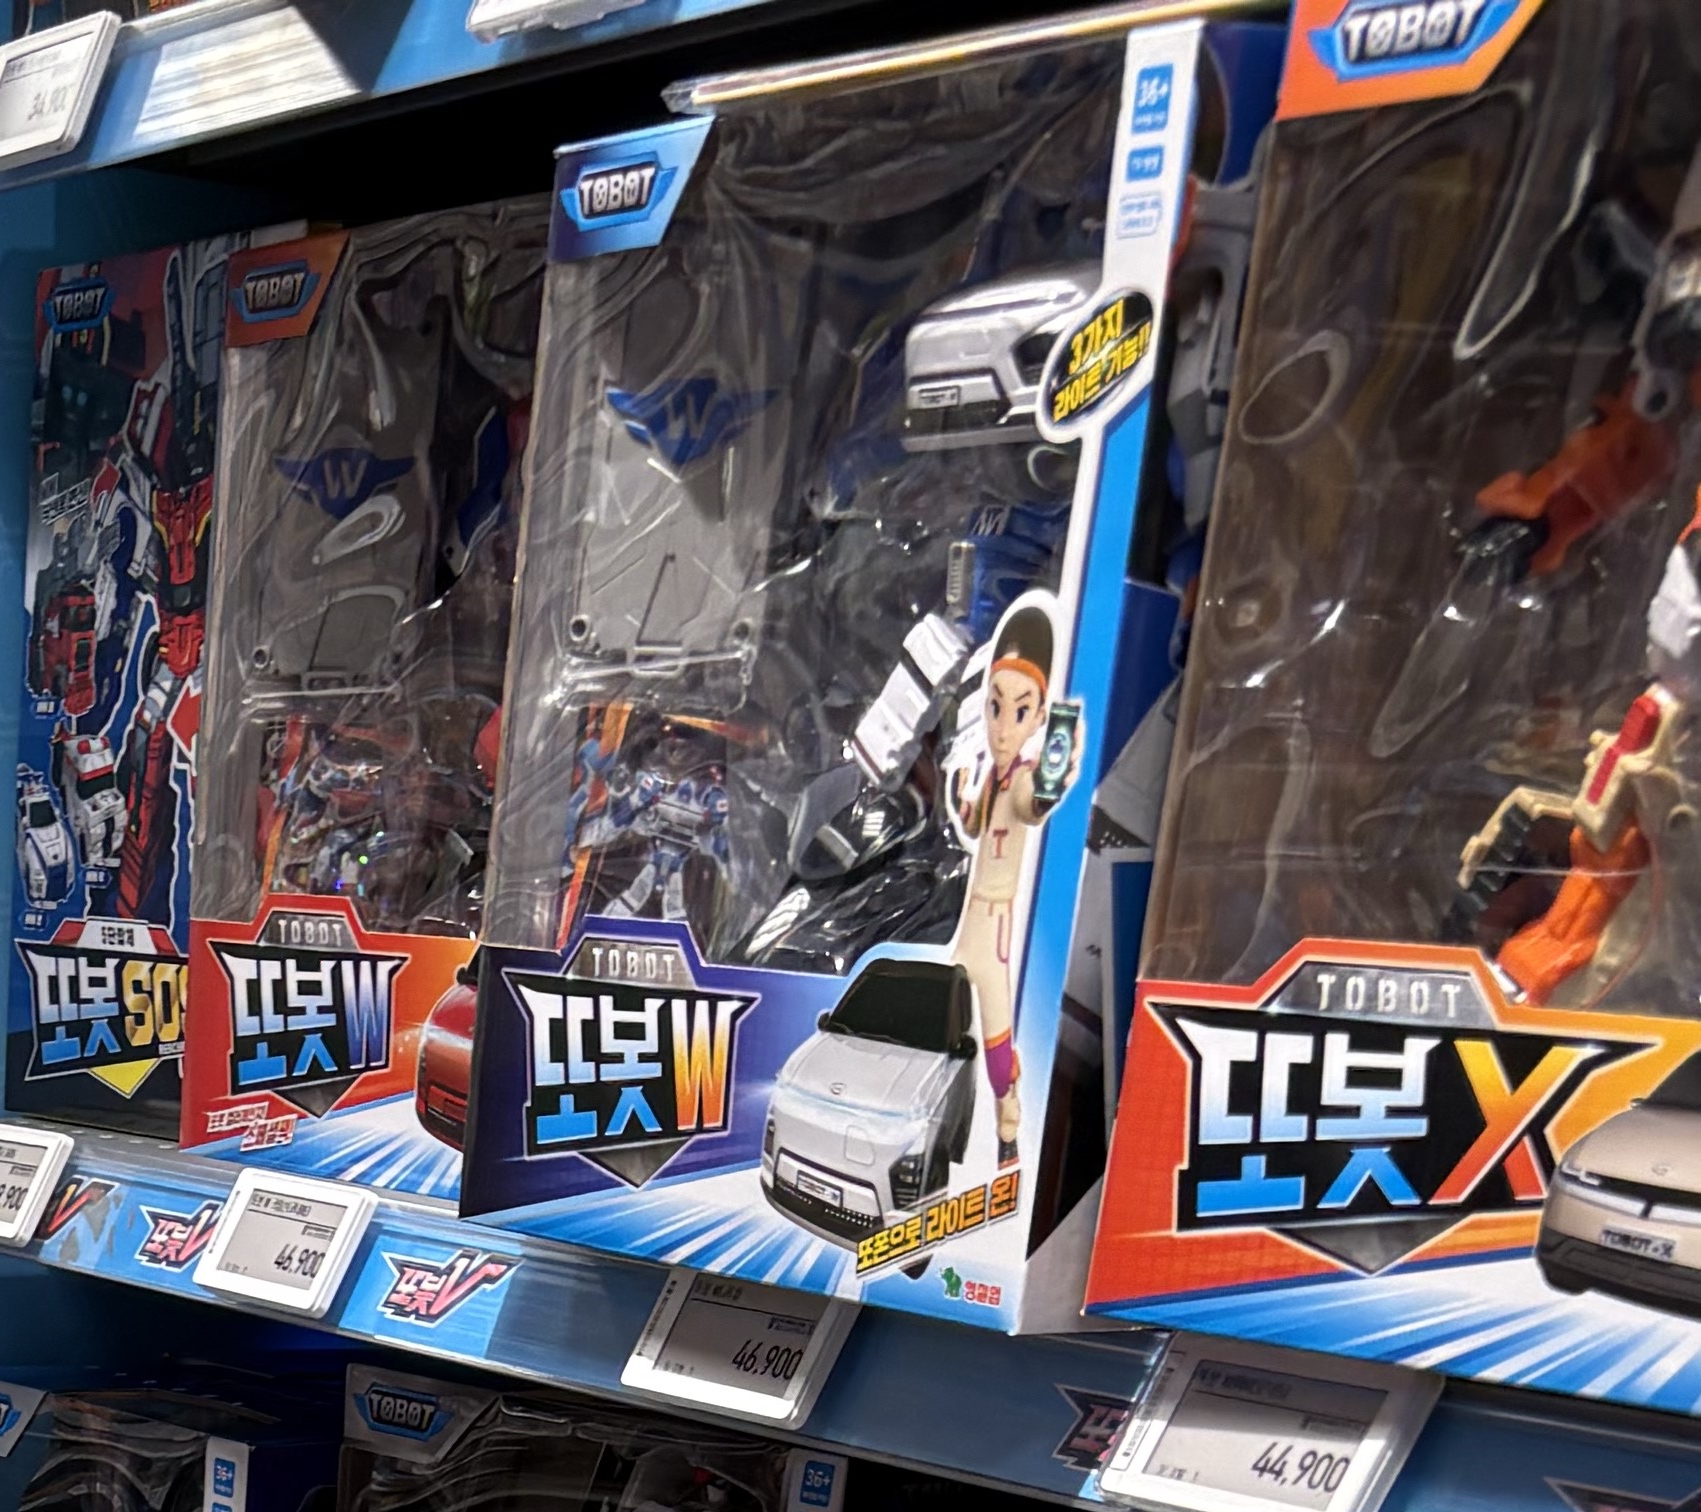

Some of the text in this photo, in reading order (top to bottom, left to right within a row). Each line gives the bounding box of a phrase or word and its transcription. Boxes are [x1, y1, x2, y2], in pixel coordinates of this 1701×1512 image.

[1342, 5, 1476, 60] TOBOT
[579, 164, 655, 217] TOBOT
[54, 287, 102, 323] TOBOT
[247, 270, 305, 310] TOBOT
[1068, 297, 1125, 376] 3가지
[1053, 357, 1102, 424] 라이트
[278, 918, 344, 947] TOBOT
[591, 945, 677, 982] TOBOT
[1315, 972, 1463, 1018] TOBOT
[856, 1171, 1020, 1273] 또폰으로 라이트 온!
[272, 1243, 328, 1280] 46,900
[396, 1253, 508, 1322] 또봇V
[730, 1338, 802, 1382] 46,900
[368, 1391, 436, 1432] TOBOT
[1249, 1439, 1351, 1497] 44,900
